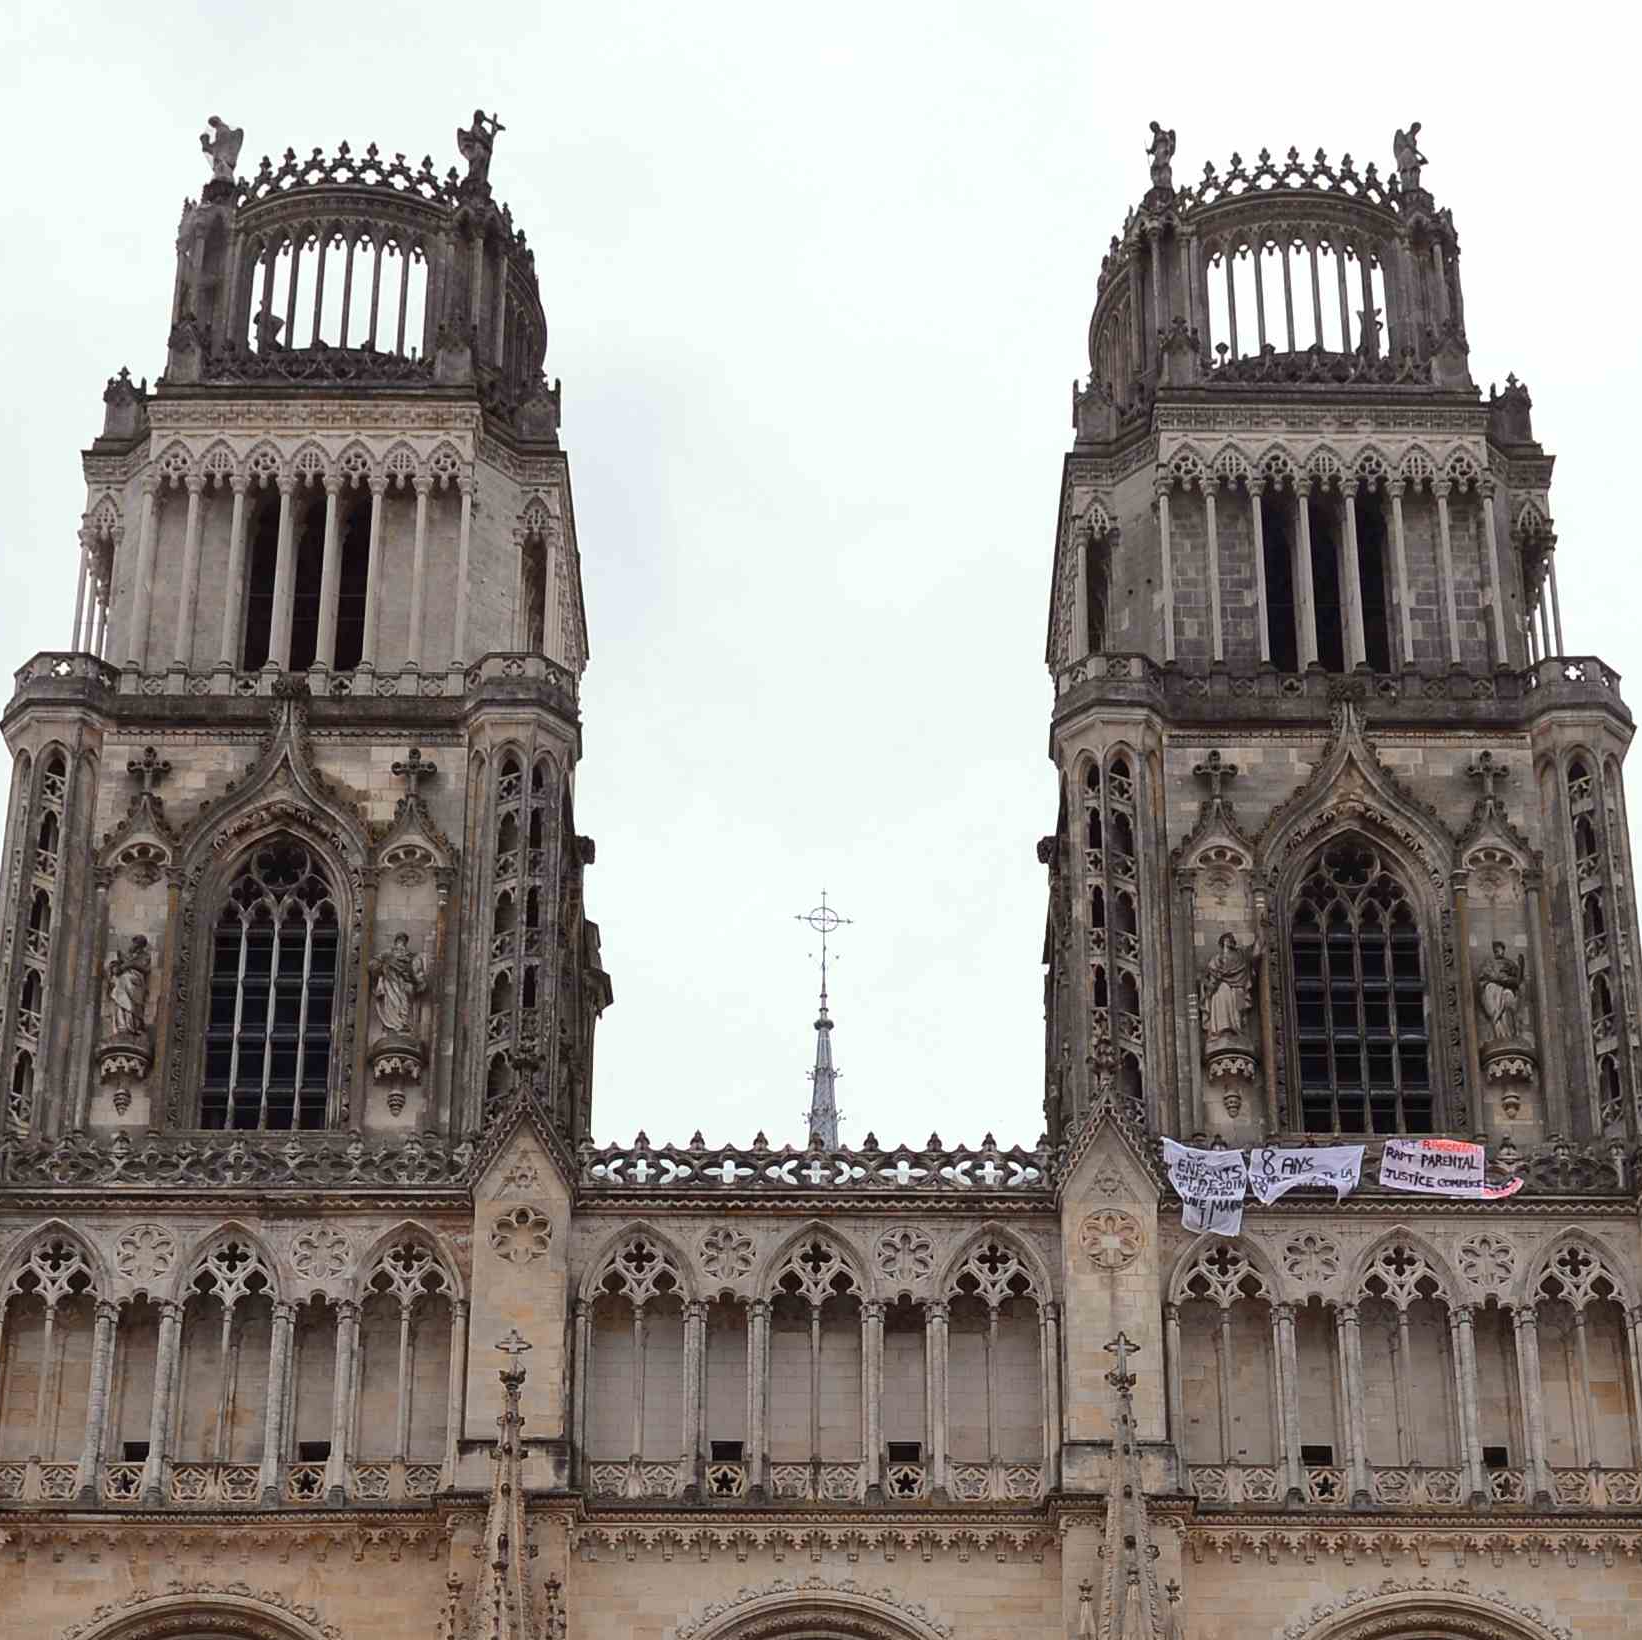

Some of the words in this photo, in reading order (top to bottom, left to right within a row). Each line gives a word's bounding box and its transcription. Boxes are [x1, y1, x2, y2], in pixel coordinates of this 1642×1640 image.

[1261, 1149, 1275, 1176] 8
[1385, 1146, 1415, 1164] RAPT
[1420, 1153, 1480, 1171] PARENTAL
[1385, 1167, 1435, 1188] JUSTICE
